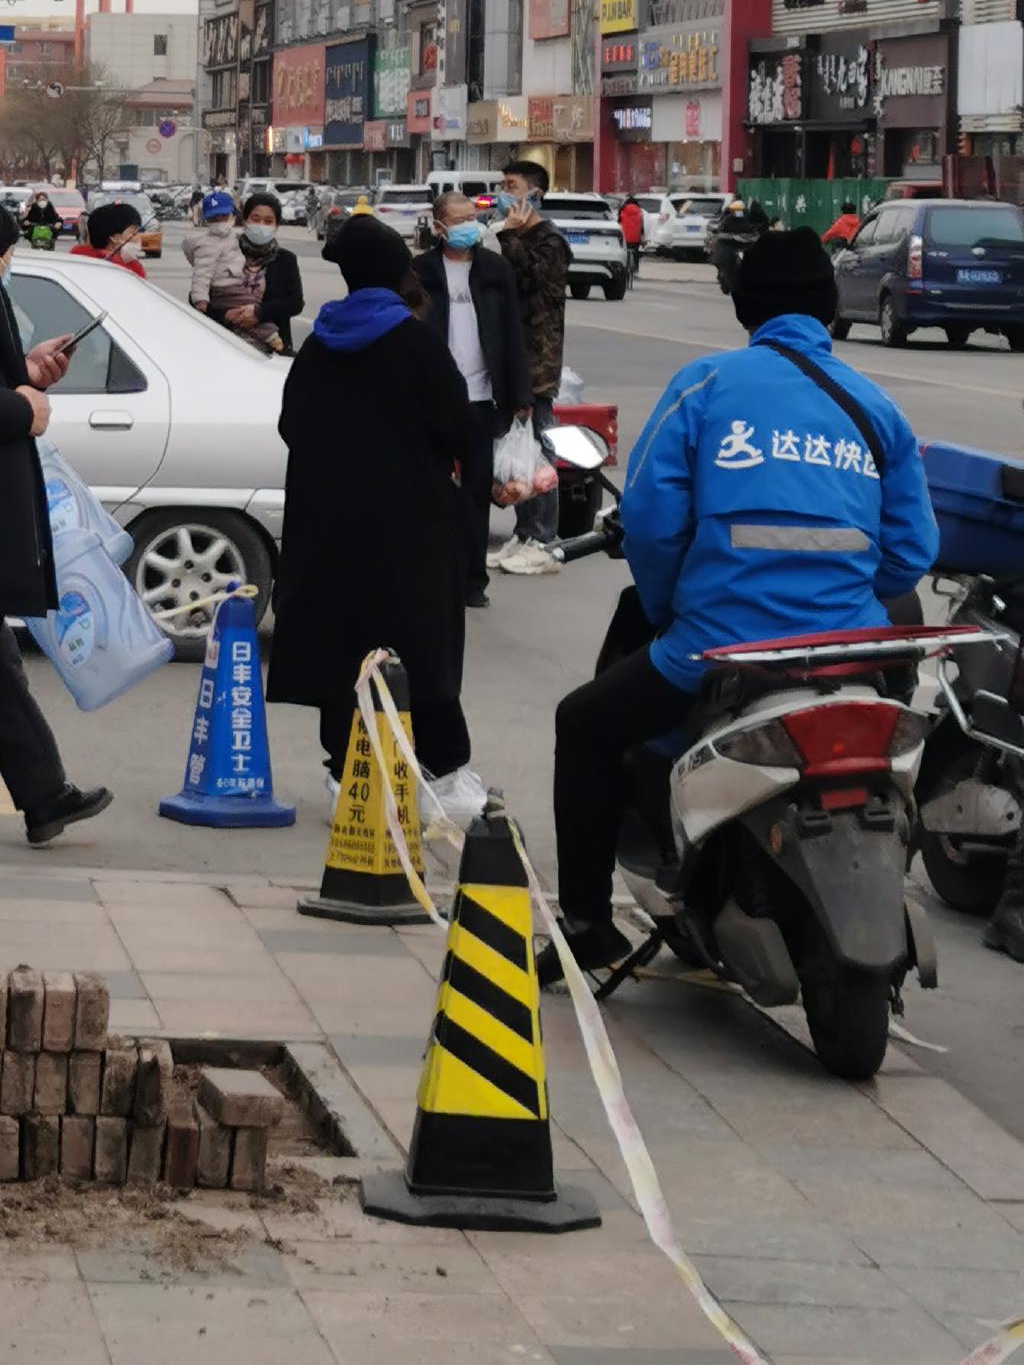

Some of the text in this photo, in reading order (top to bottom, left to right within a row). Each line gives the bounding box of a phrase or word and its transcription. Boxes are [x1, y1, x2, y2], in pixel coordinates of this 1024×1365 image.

[231, 641, 252, 773] 日丰安全卫士
